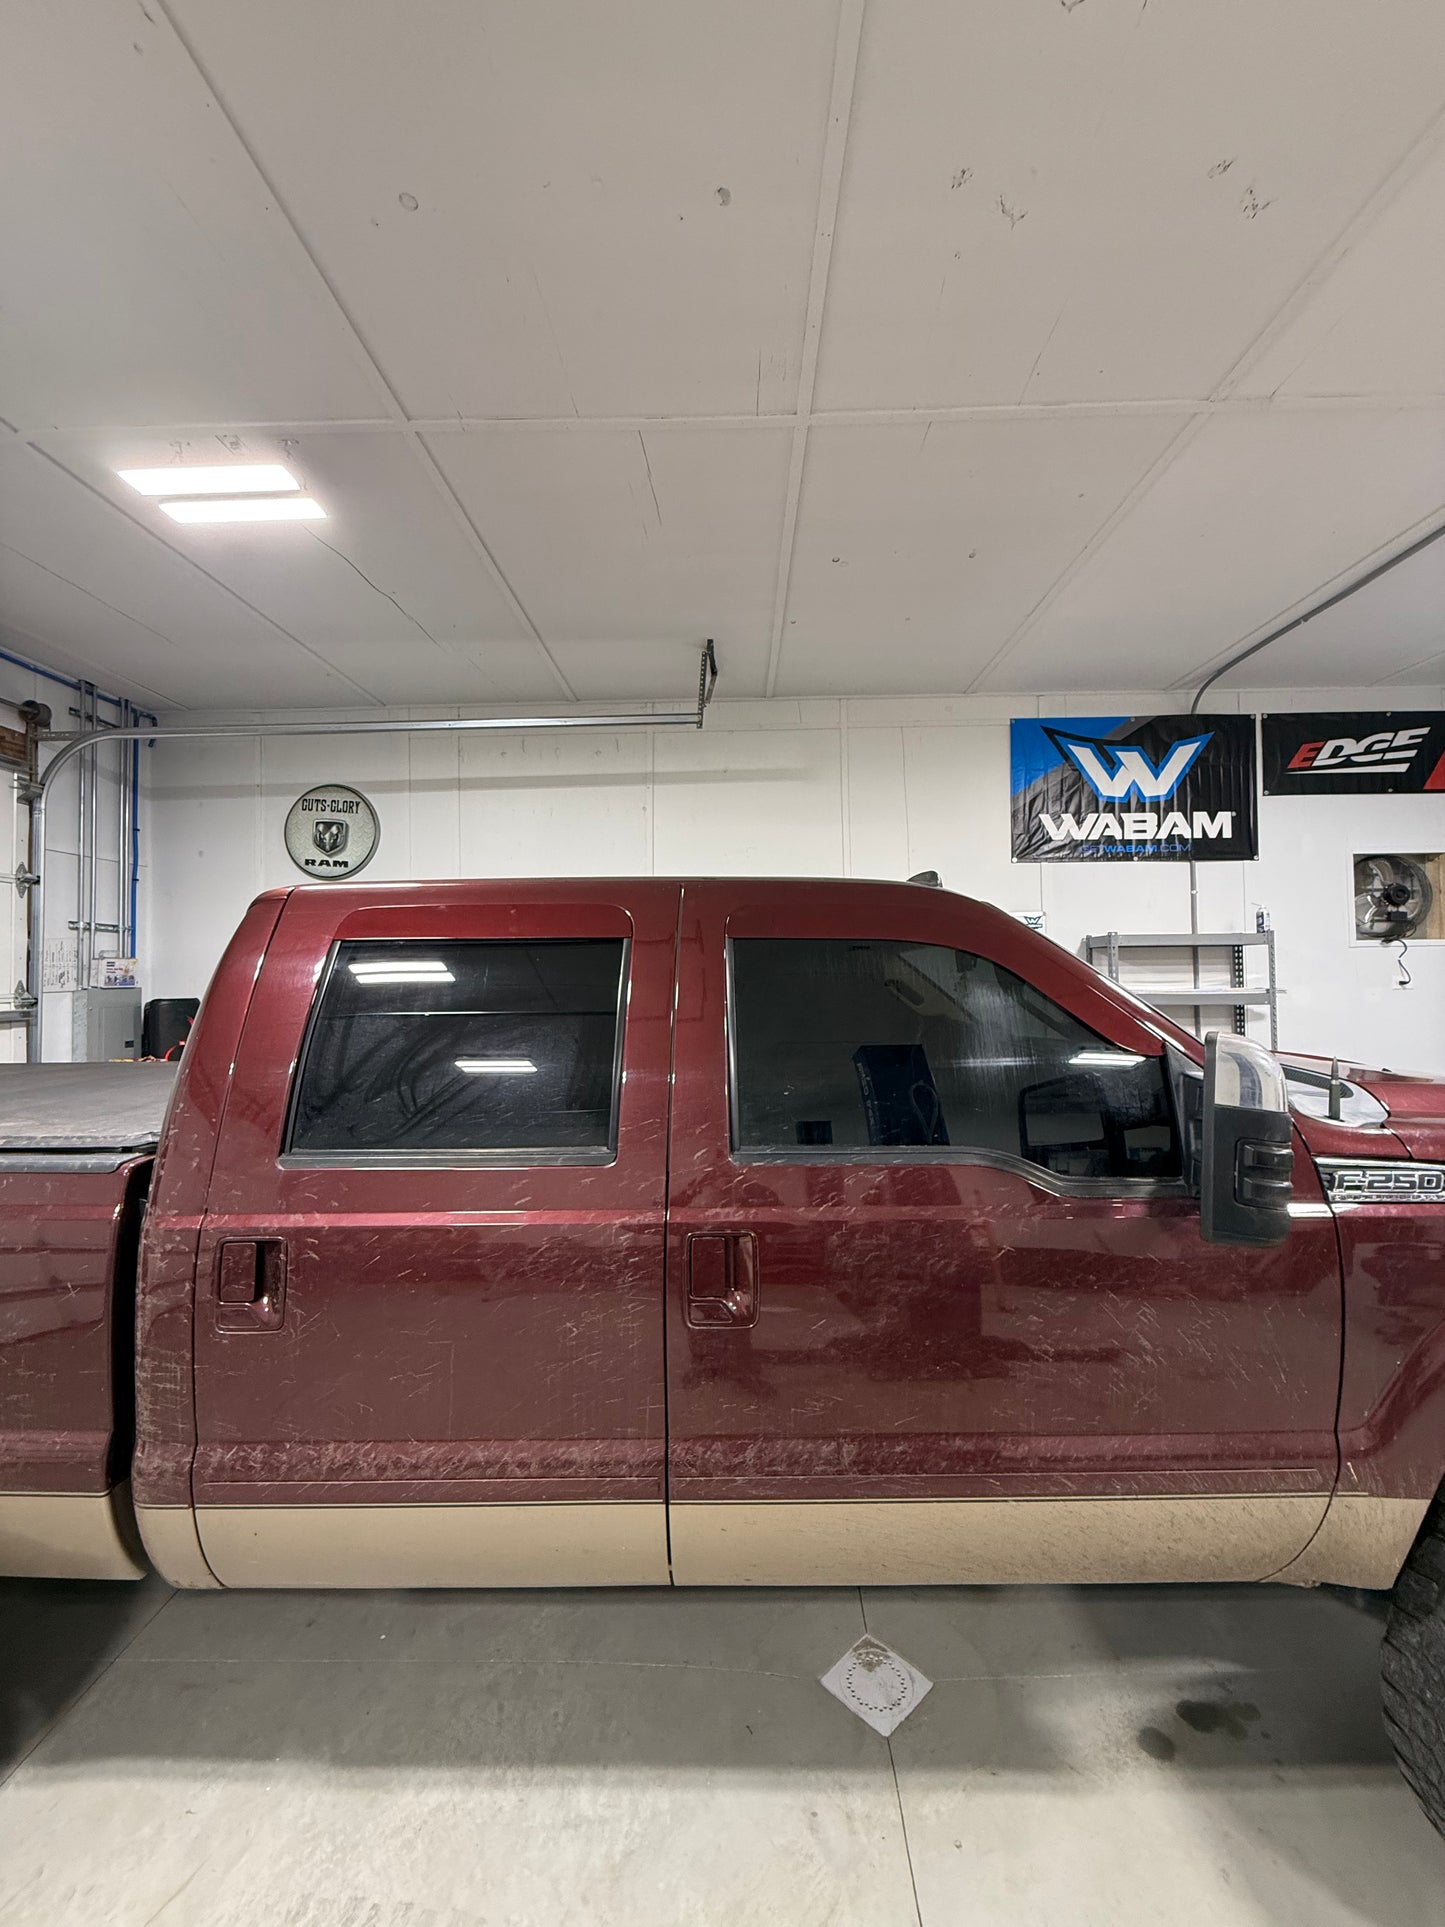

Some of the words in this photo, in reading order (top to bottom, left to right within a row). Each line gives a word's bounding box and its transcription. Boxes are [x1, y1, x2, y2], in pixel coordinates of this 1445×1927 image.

[1287, 726, 1431, 769] EDGE
[1038, 811, 1233, 841] WABAM
[304, 858, 349, 868] RAM
[1333, 1170, 1445, 1193] F-250
